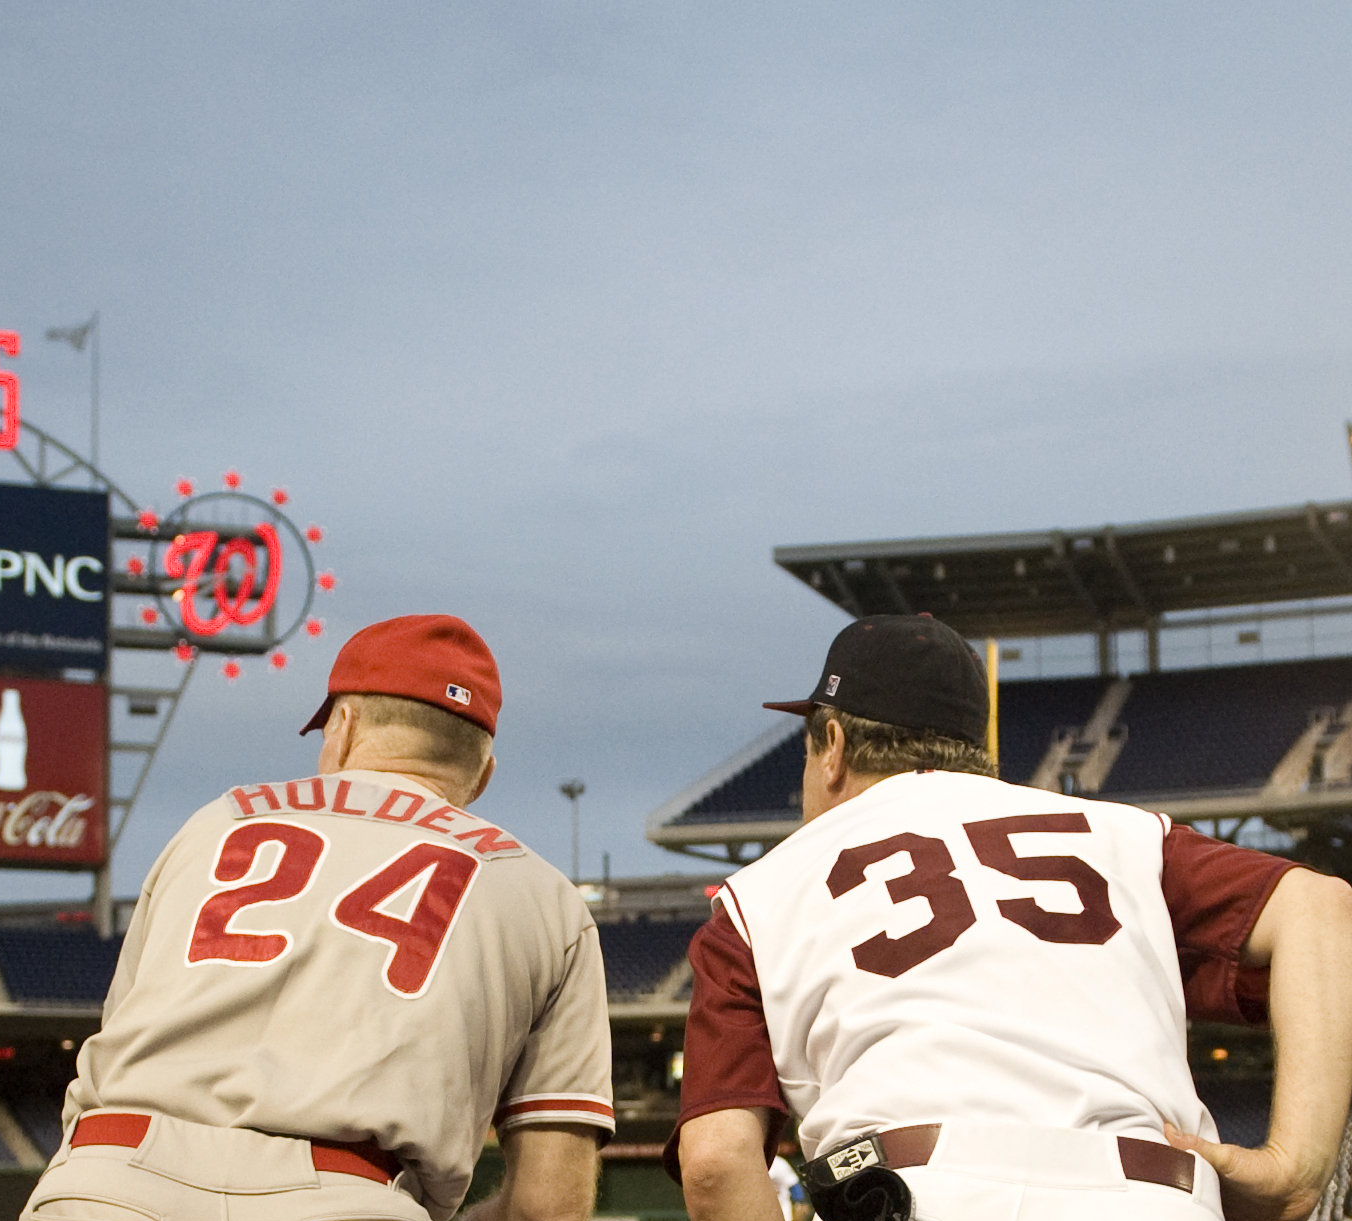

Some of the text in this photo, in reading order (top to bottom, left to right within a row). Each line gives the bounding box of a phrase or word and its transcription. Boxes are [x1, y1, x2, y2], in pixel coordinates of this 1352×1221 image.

[231, 776, 522, 855] HOLDEN
[826, 812, 1122, 979] 35
[184, 818, 482, 1000] 24
